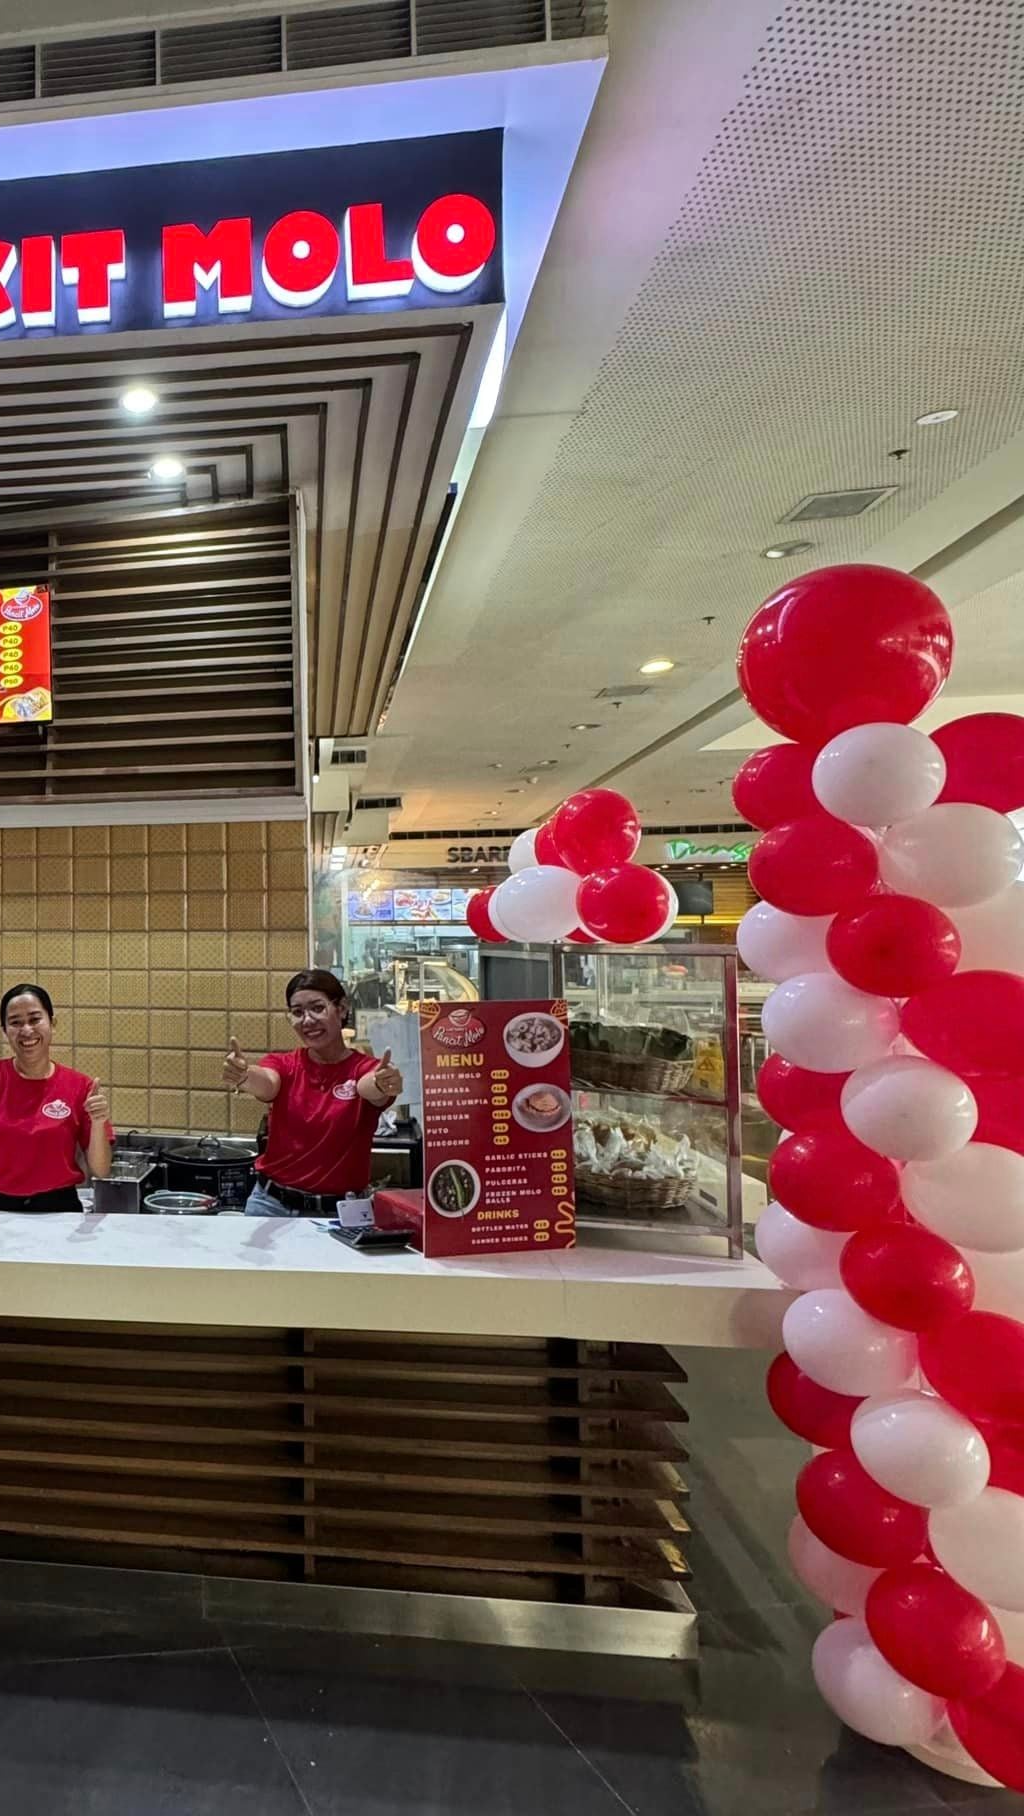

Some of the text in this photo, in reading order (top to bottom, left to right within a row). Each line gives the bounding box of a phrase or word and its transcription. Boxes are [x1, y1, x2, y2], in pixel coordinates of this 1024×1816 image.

[162, 192, 495, 316] MOLO
[436, 1053, 484, 1067] MENU
[477, 1209, 520, 1220] DRINKS
